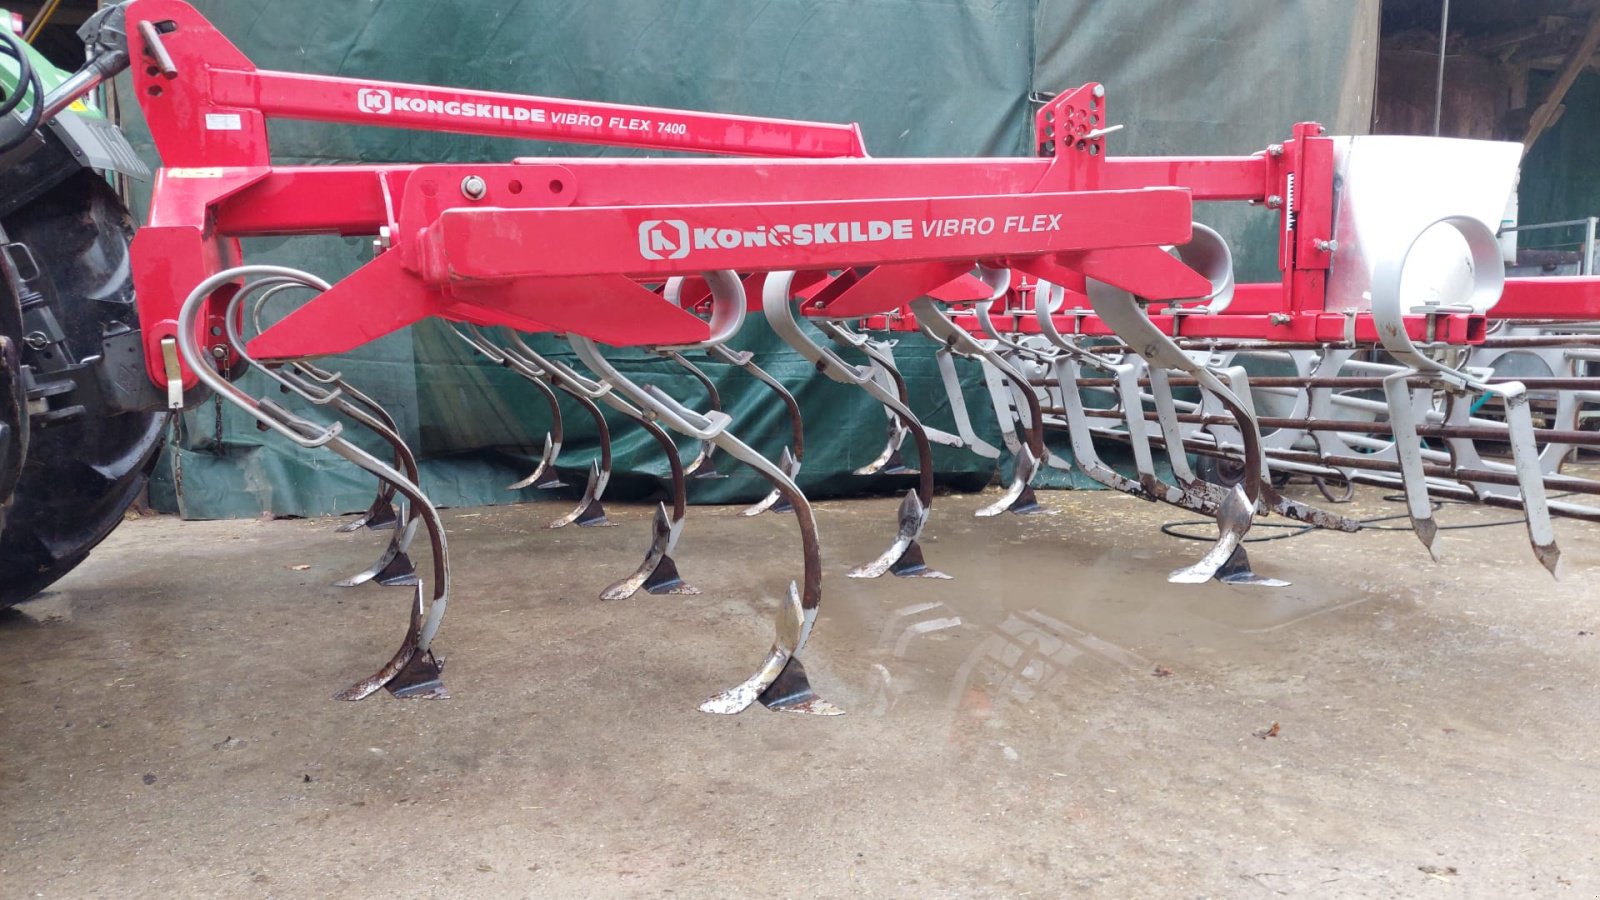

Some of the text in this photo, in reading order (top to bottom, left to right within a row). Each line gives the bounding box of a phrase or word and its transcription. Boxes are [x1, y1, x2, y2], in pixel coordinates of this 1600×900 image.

[394, 96, 546, 123] KONGSKILDE
[551, 111, 603, 127] VIBRO
[608, 117, 651, 131] FLEX
[657, 121, 687, 135] 7400
[694, 218, 913, 250] KONGSKILDE
[921, 217, 995, 238] VIBRO
[1003, 213, 1063, 233] FLEX
